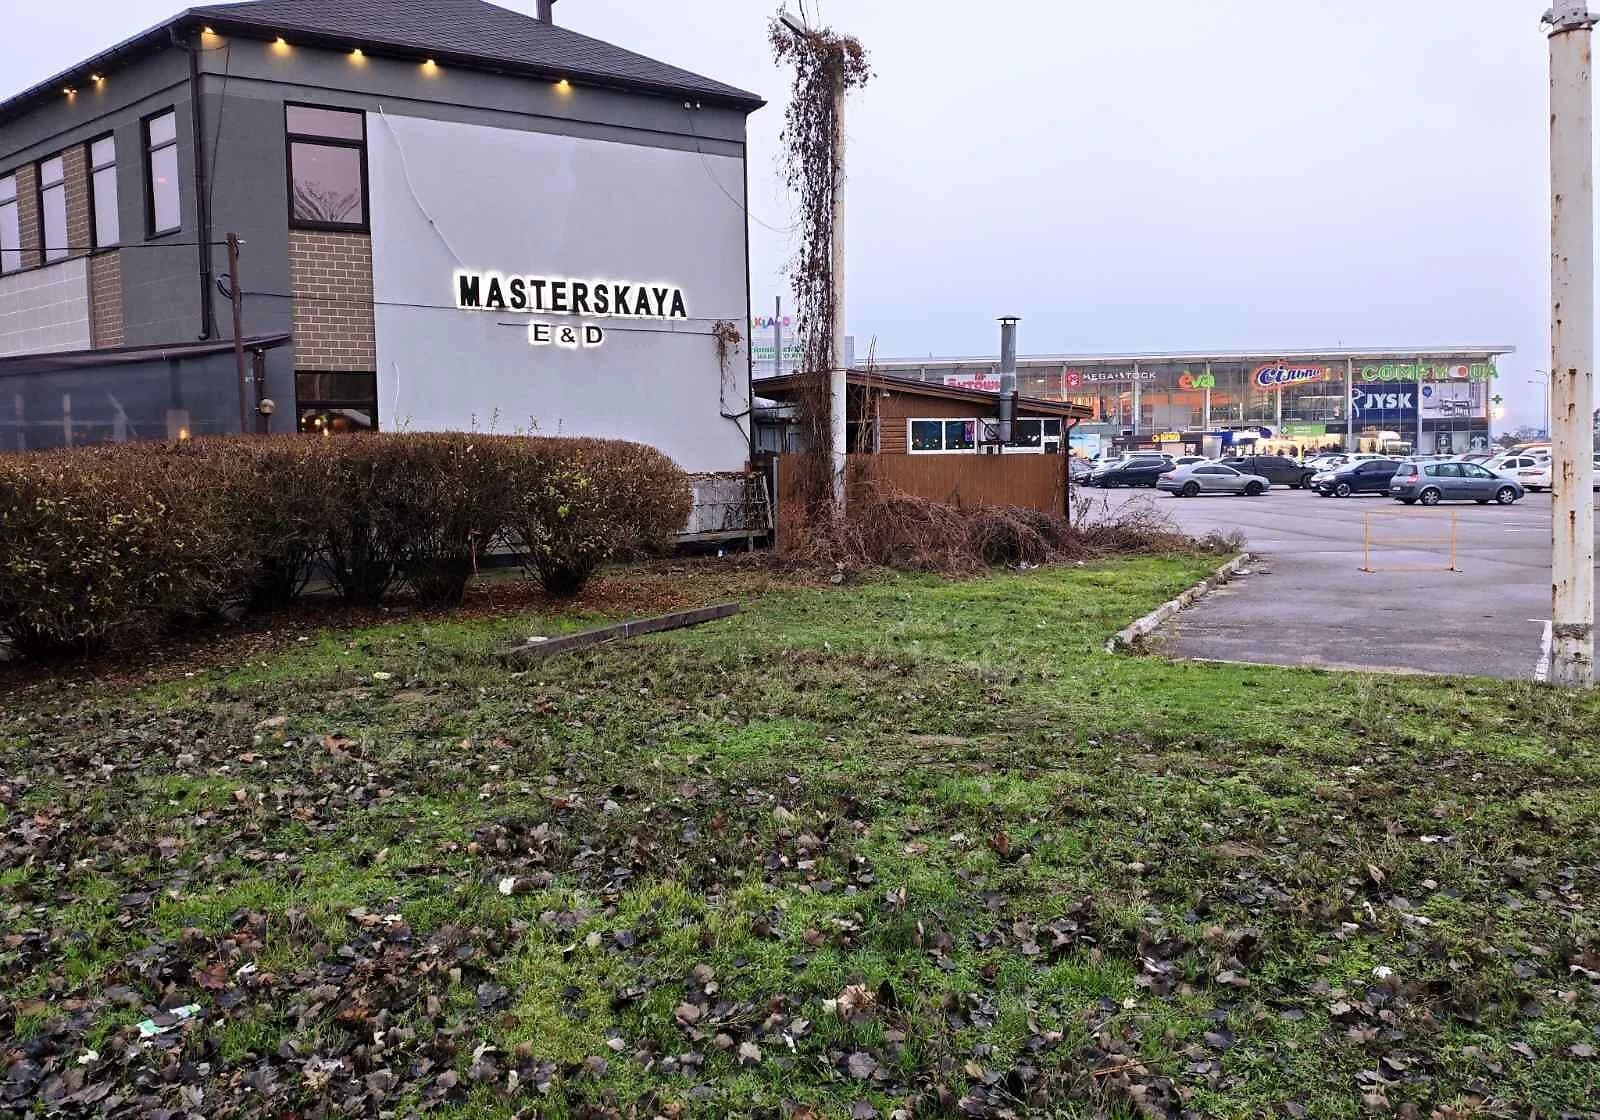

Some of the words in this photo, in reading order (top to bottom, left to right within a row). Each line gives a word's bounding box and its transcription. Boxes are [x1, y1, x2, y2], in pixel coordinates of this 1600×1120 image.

[459, 275, 687, 317] MASTERSKAYA
[533, 323, 550, 342] E
[560, 327, 576, 343] &
[585, 325, 603, 343] D
[1363, 393, 1414, 409] JYSK
